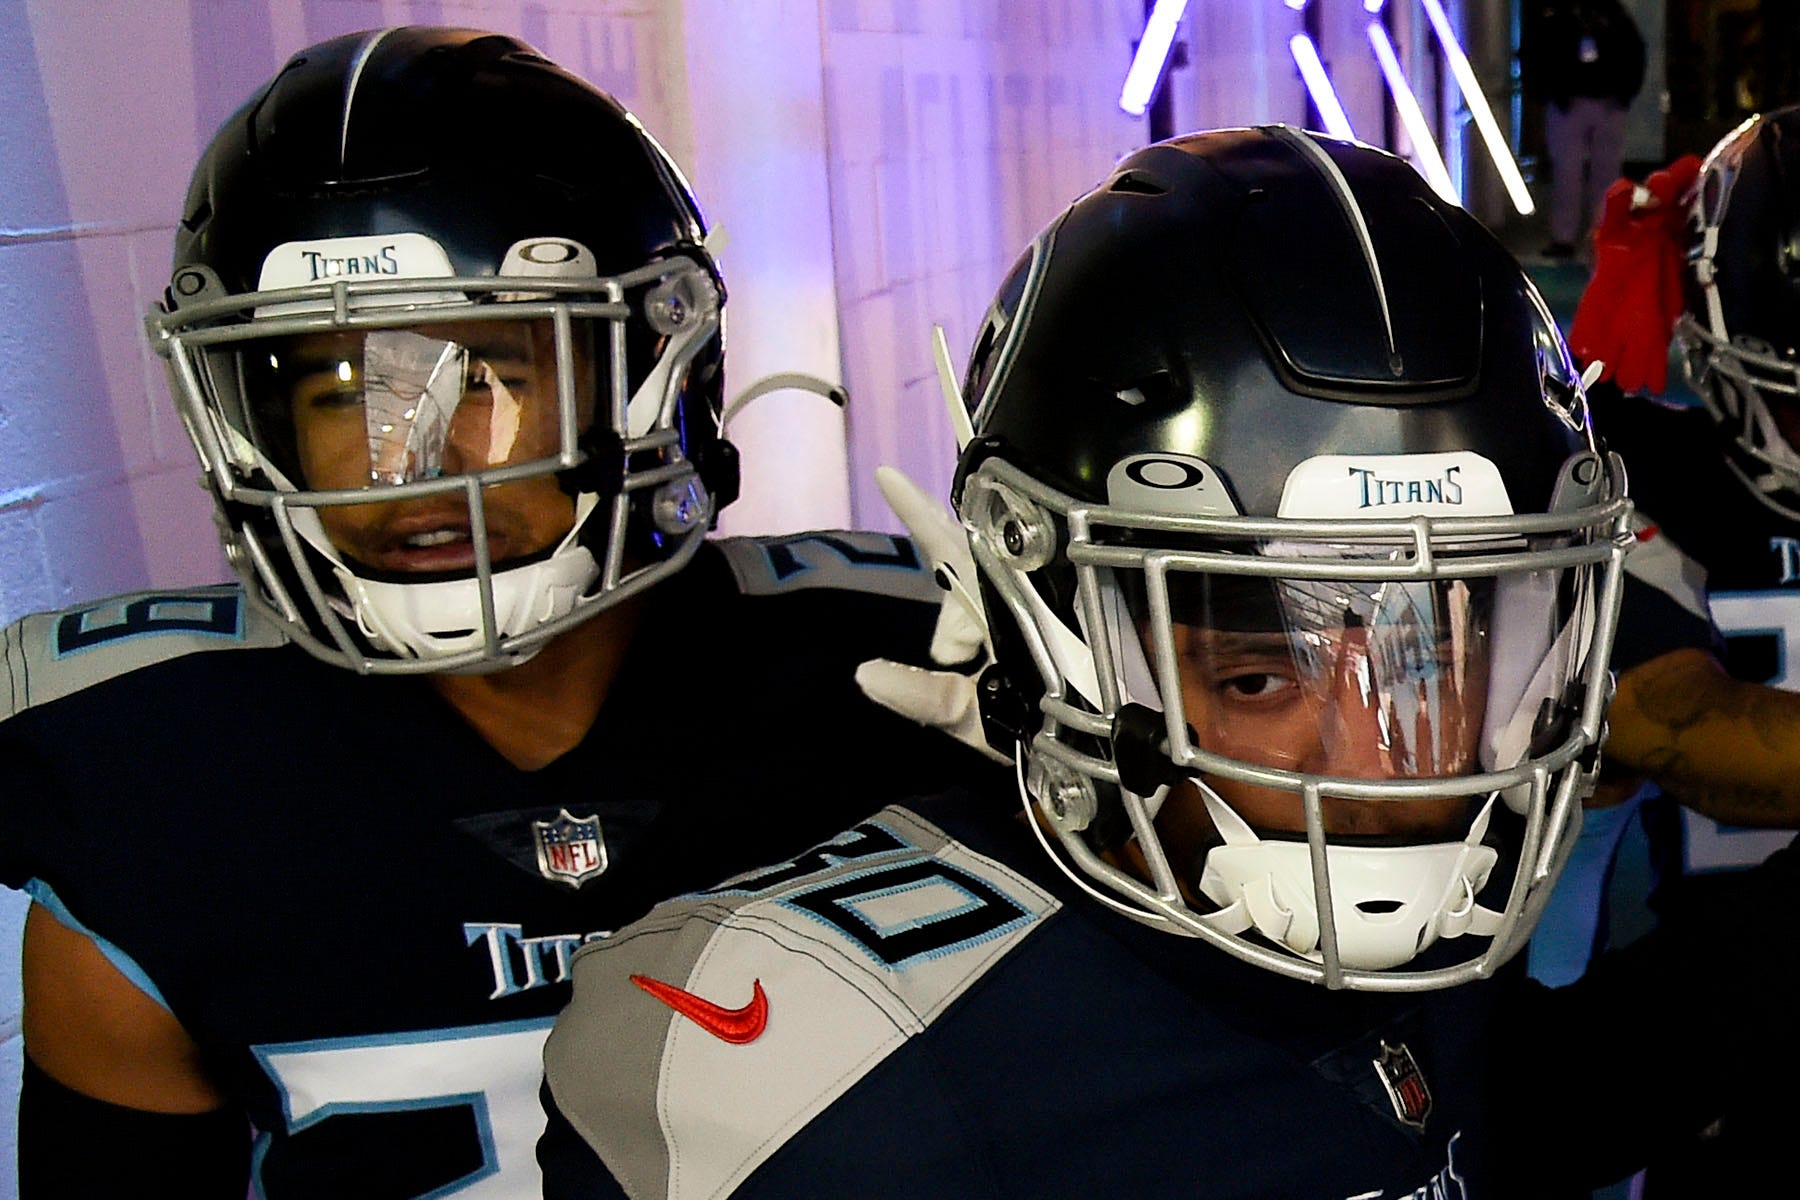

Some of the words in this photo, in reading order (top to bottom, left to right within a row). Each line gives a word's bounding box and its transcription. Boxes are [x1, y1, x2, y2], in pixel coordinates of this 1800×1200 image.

[302, 246, 398, 282] TITANS
[1349, 466, 1463, 508] TITANS
[552, 843, 597, 872] NFL
[463, 921, 613, 1001] TIT
